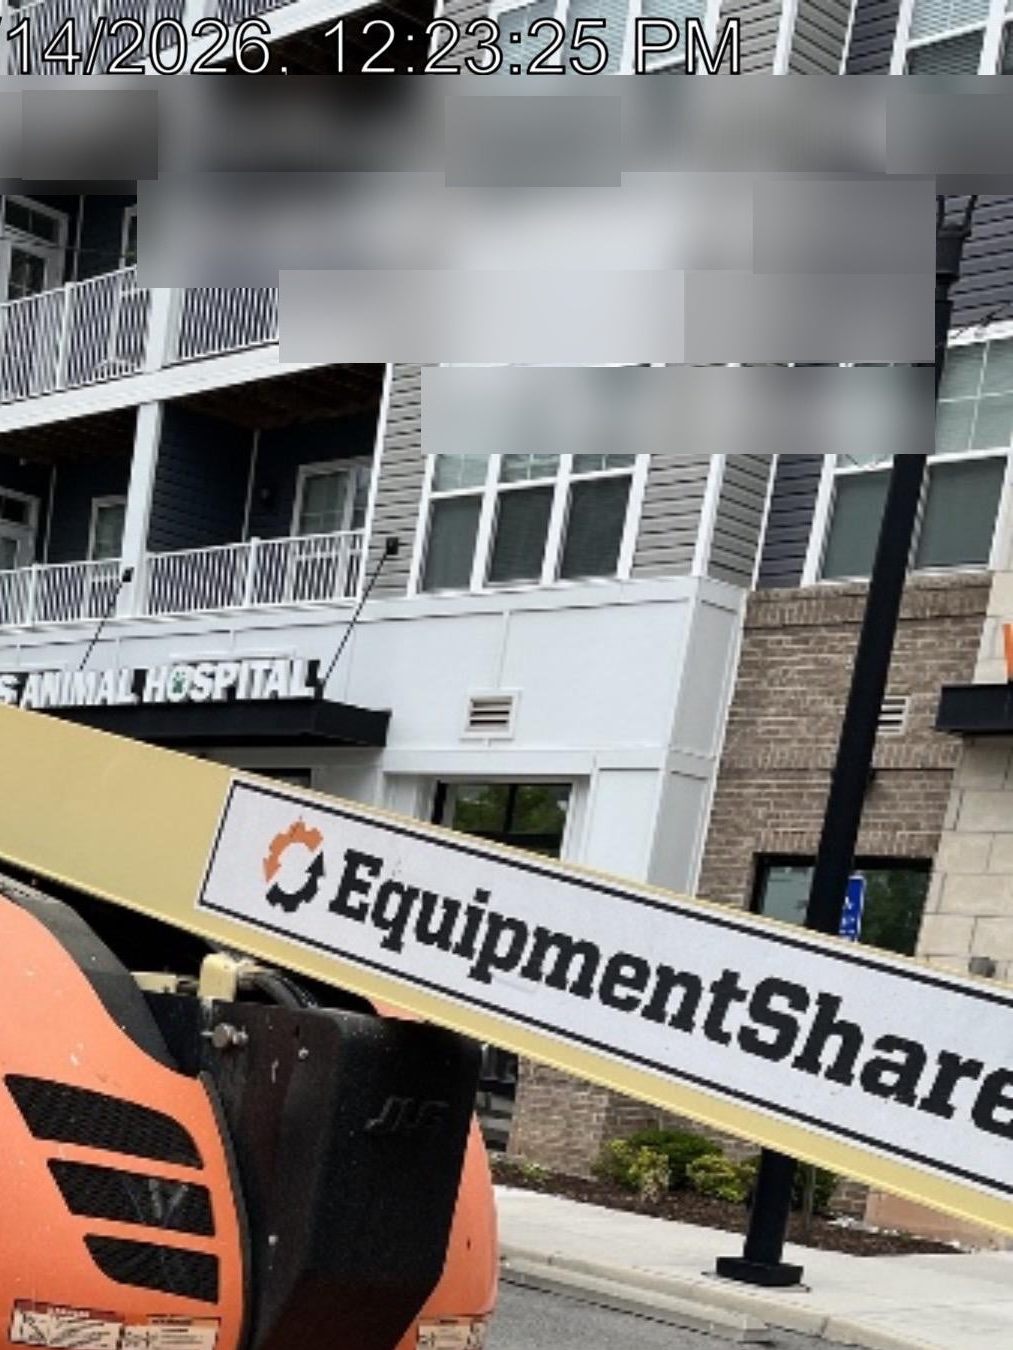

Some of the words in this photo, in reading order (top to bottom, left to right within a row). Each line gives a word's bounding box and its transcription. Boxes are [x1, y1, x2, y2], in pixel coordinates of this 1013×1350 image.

[19, 668, 139, 709] ANIMAL
[142, 658, 316, 702] HOSPITAL
[328, 848, 1013, 1140] EquipmentShare
